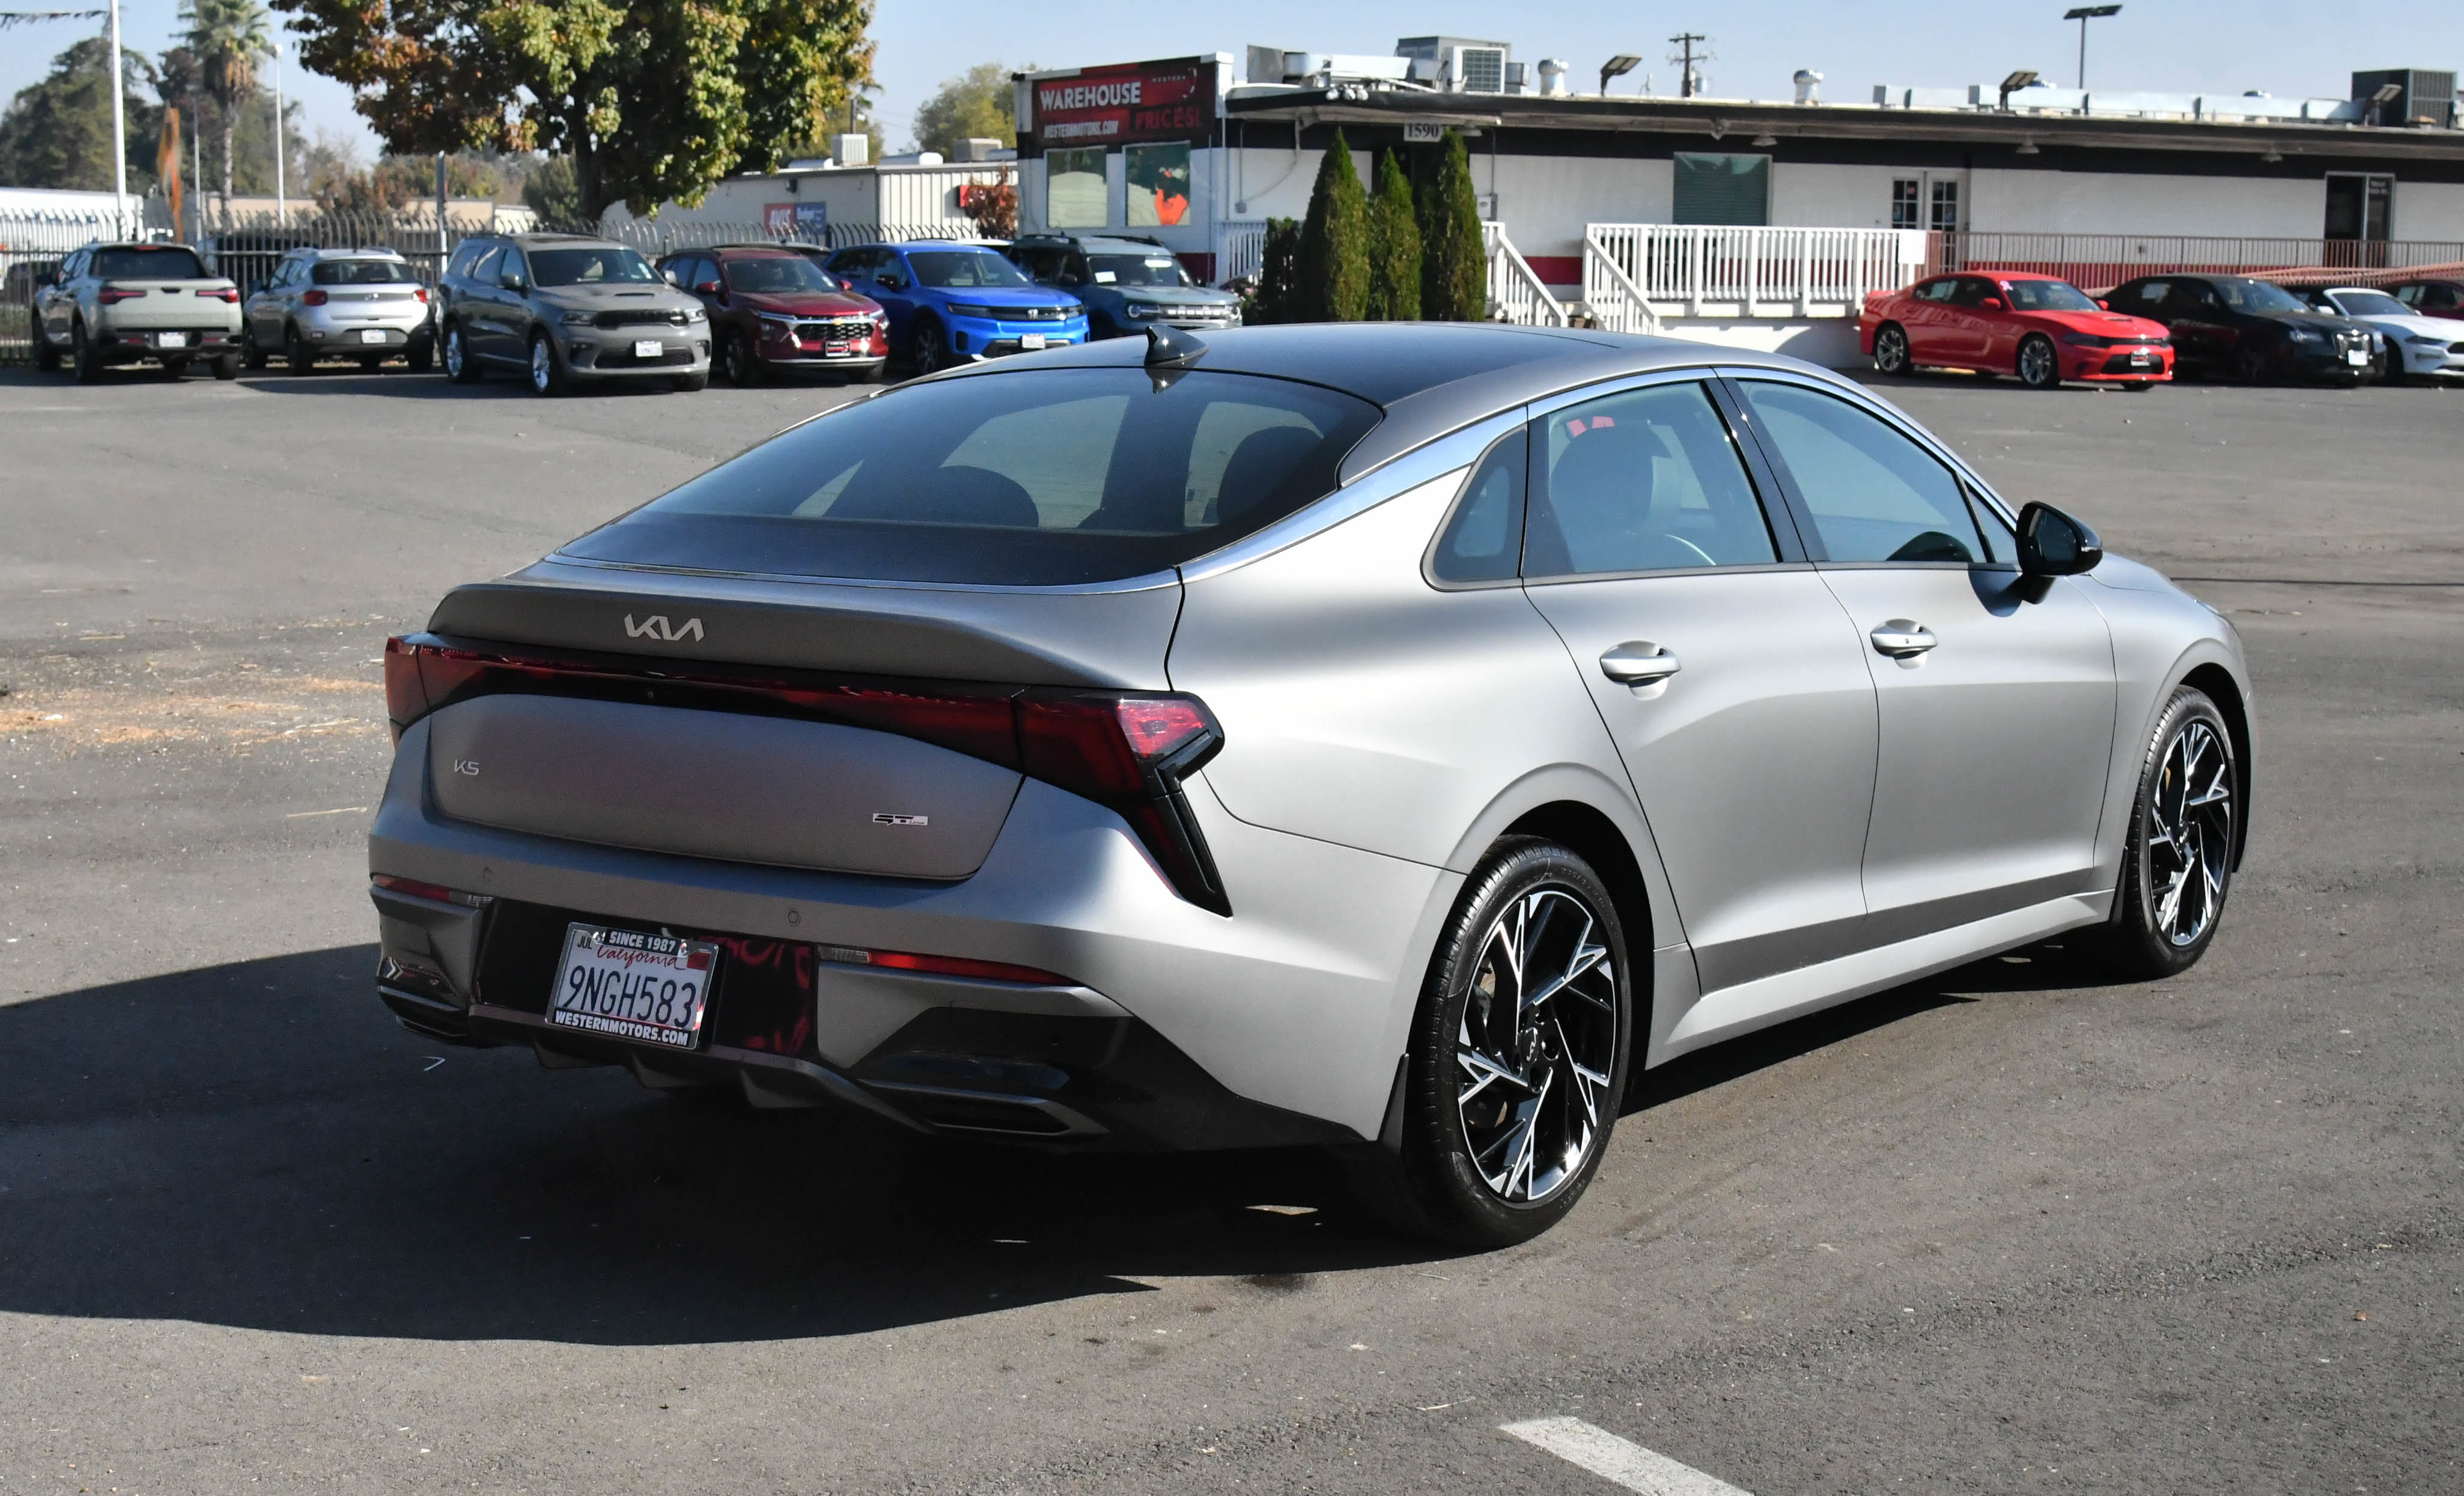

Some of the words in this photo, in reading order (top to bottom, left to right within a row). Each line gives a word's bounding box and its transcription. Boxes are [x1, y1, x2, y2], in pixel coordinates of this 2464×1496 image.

[1040, 81, 1142, 112] WAREHOUSE
[1134, 105, 1200, 131] PRICES!
[1408, 123, 1439, 138] 1590
[624, 613, 705, 643] KIA
[454, 759, 480, 776] K5
[577, 935, 593, 950] JUL
[609, 931, 644, 949] SINCE
[647, 937, 677, 952] 1987
[596, 945, 686, 970] California
[562, 965, 696, 1029] 9NGH583
[555, 1010, 689, 1047] WESTERNMOTORS.COM
